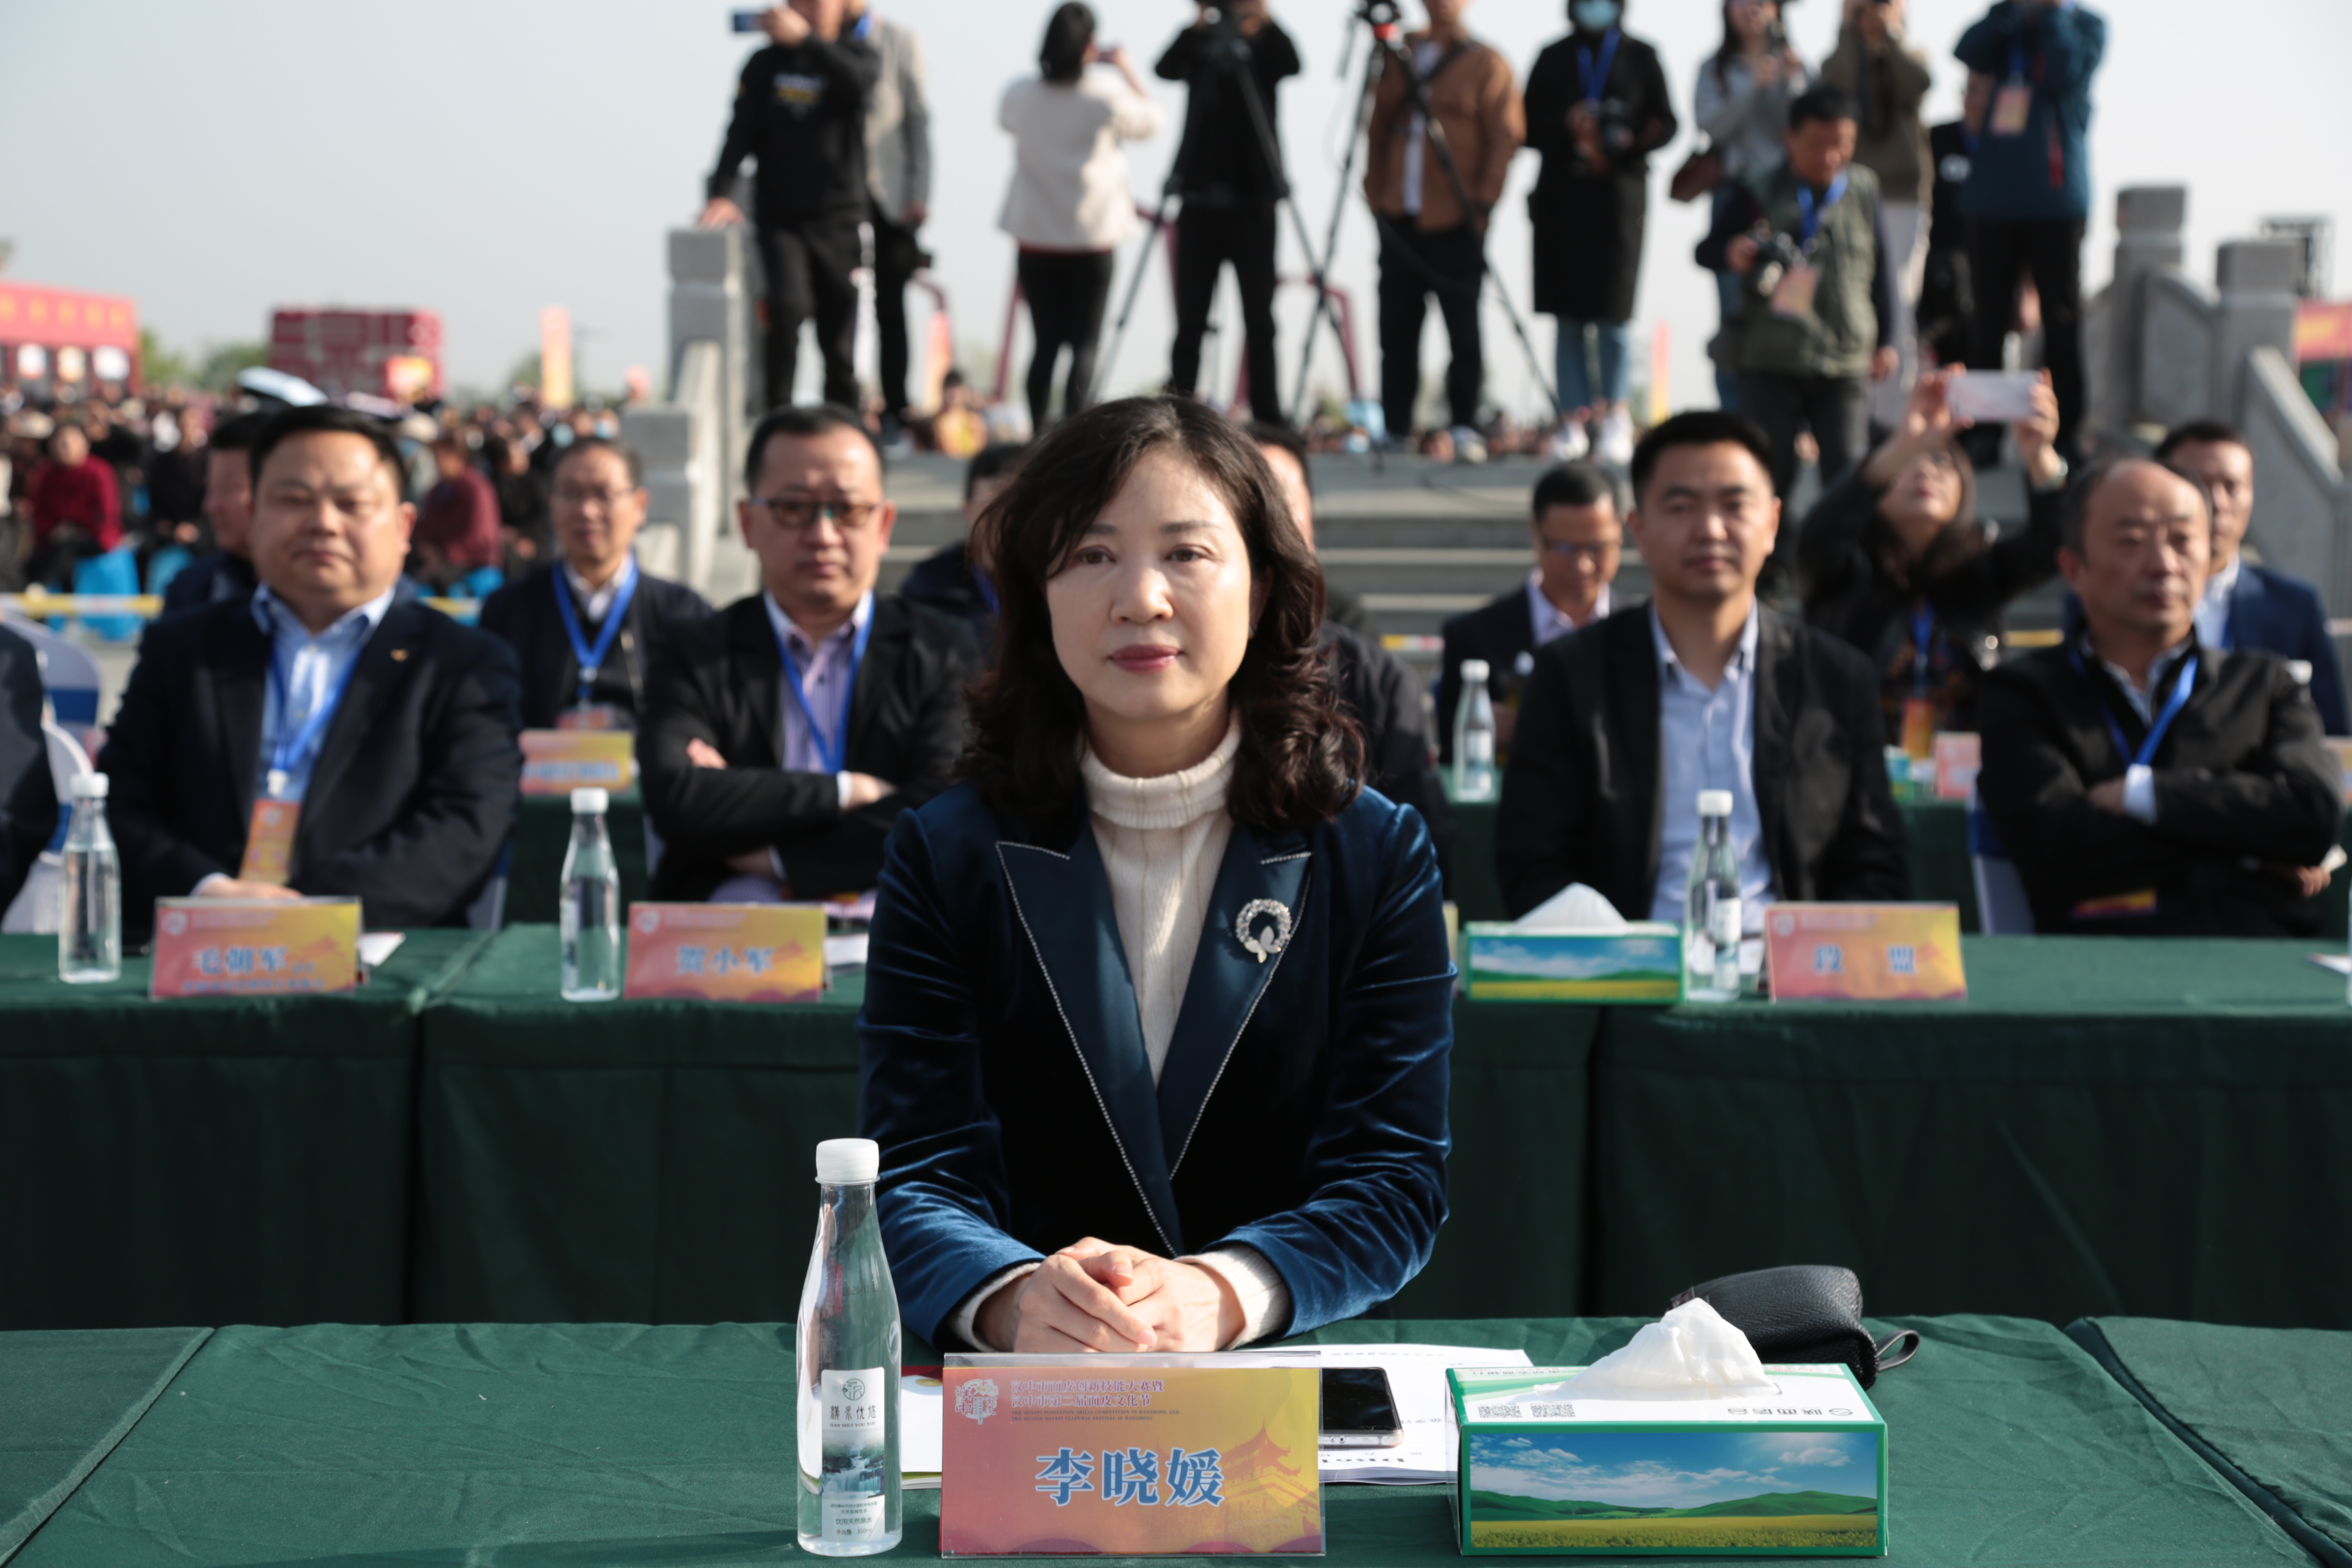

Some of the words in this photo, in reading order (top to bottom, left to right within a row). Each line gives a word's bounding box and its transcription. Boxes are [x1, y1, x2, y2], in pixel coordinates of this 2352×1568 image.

[1011, 1380, 1165, 1393] 汉中市面皮创新技能大赛暨
[1011, 1395, 1152, 1408] 汉中市第二届面皮文化节
[1035, 1447, 1224, 1507] 李晓媛
